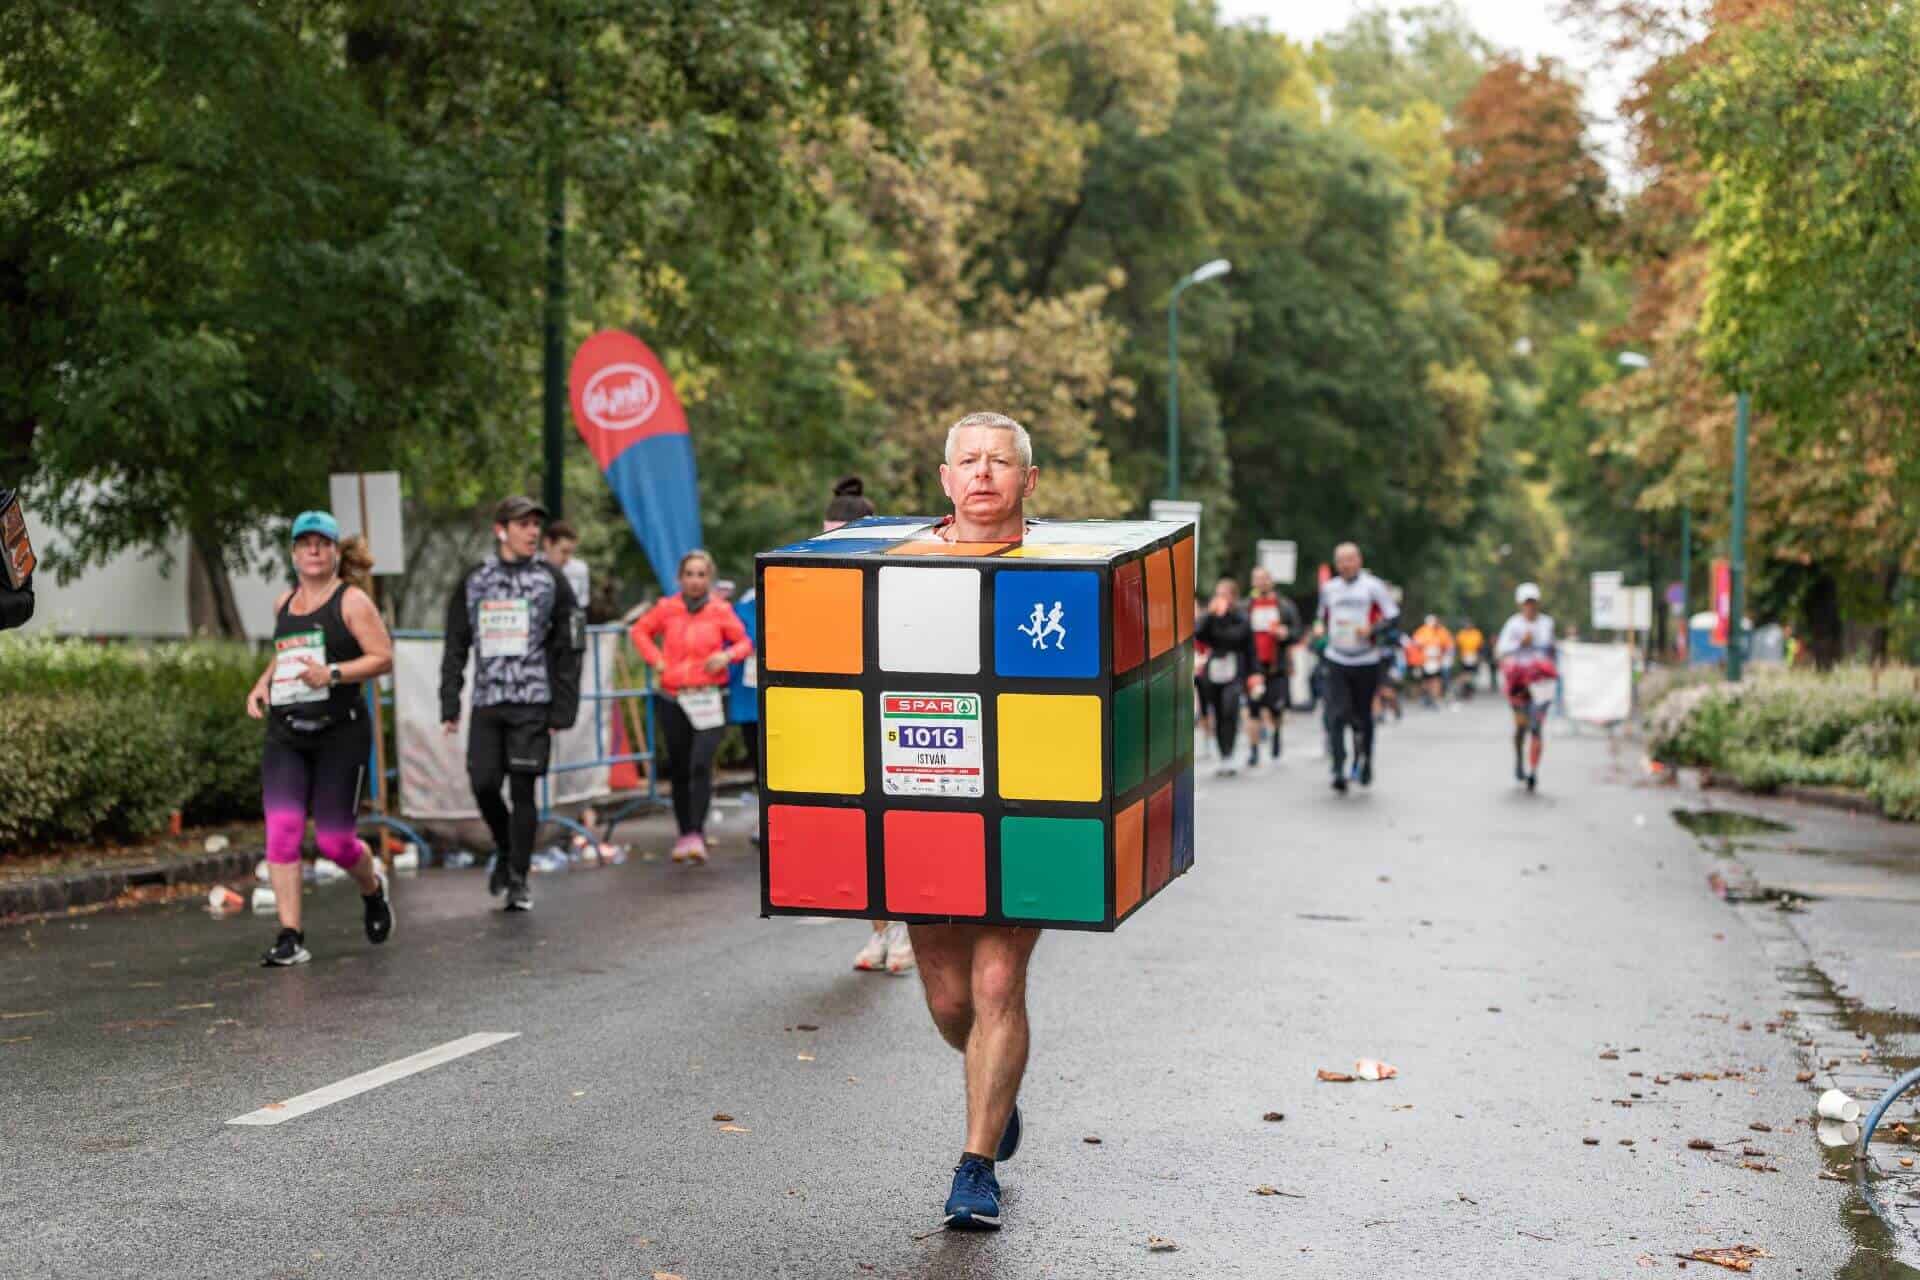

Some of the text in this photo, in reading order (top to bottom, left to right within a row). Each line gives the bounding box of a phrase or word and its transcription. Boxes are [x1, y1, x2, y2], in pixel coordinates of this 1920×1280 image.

[898, 700, 953, 712] SPAR
[888, 727, 958, 747] 5 1016
[917, 752, 947, 765] ISTVÁN
